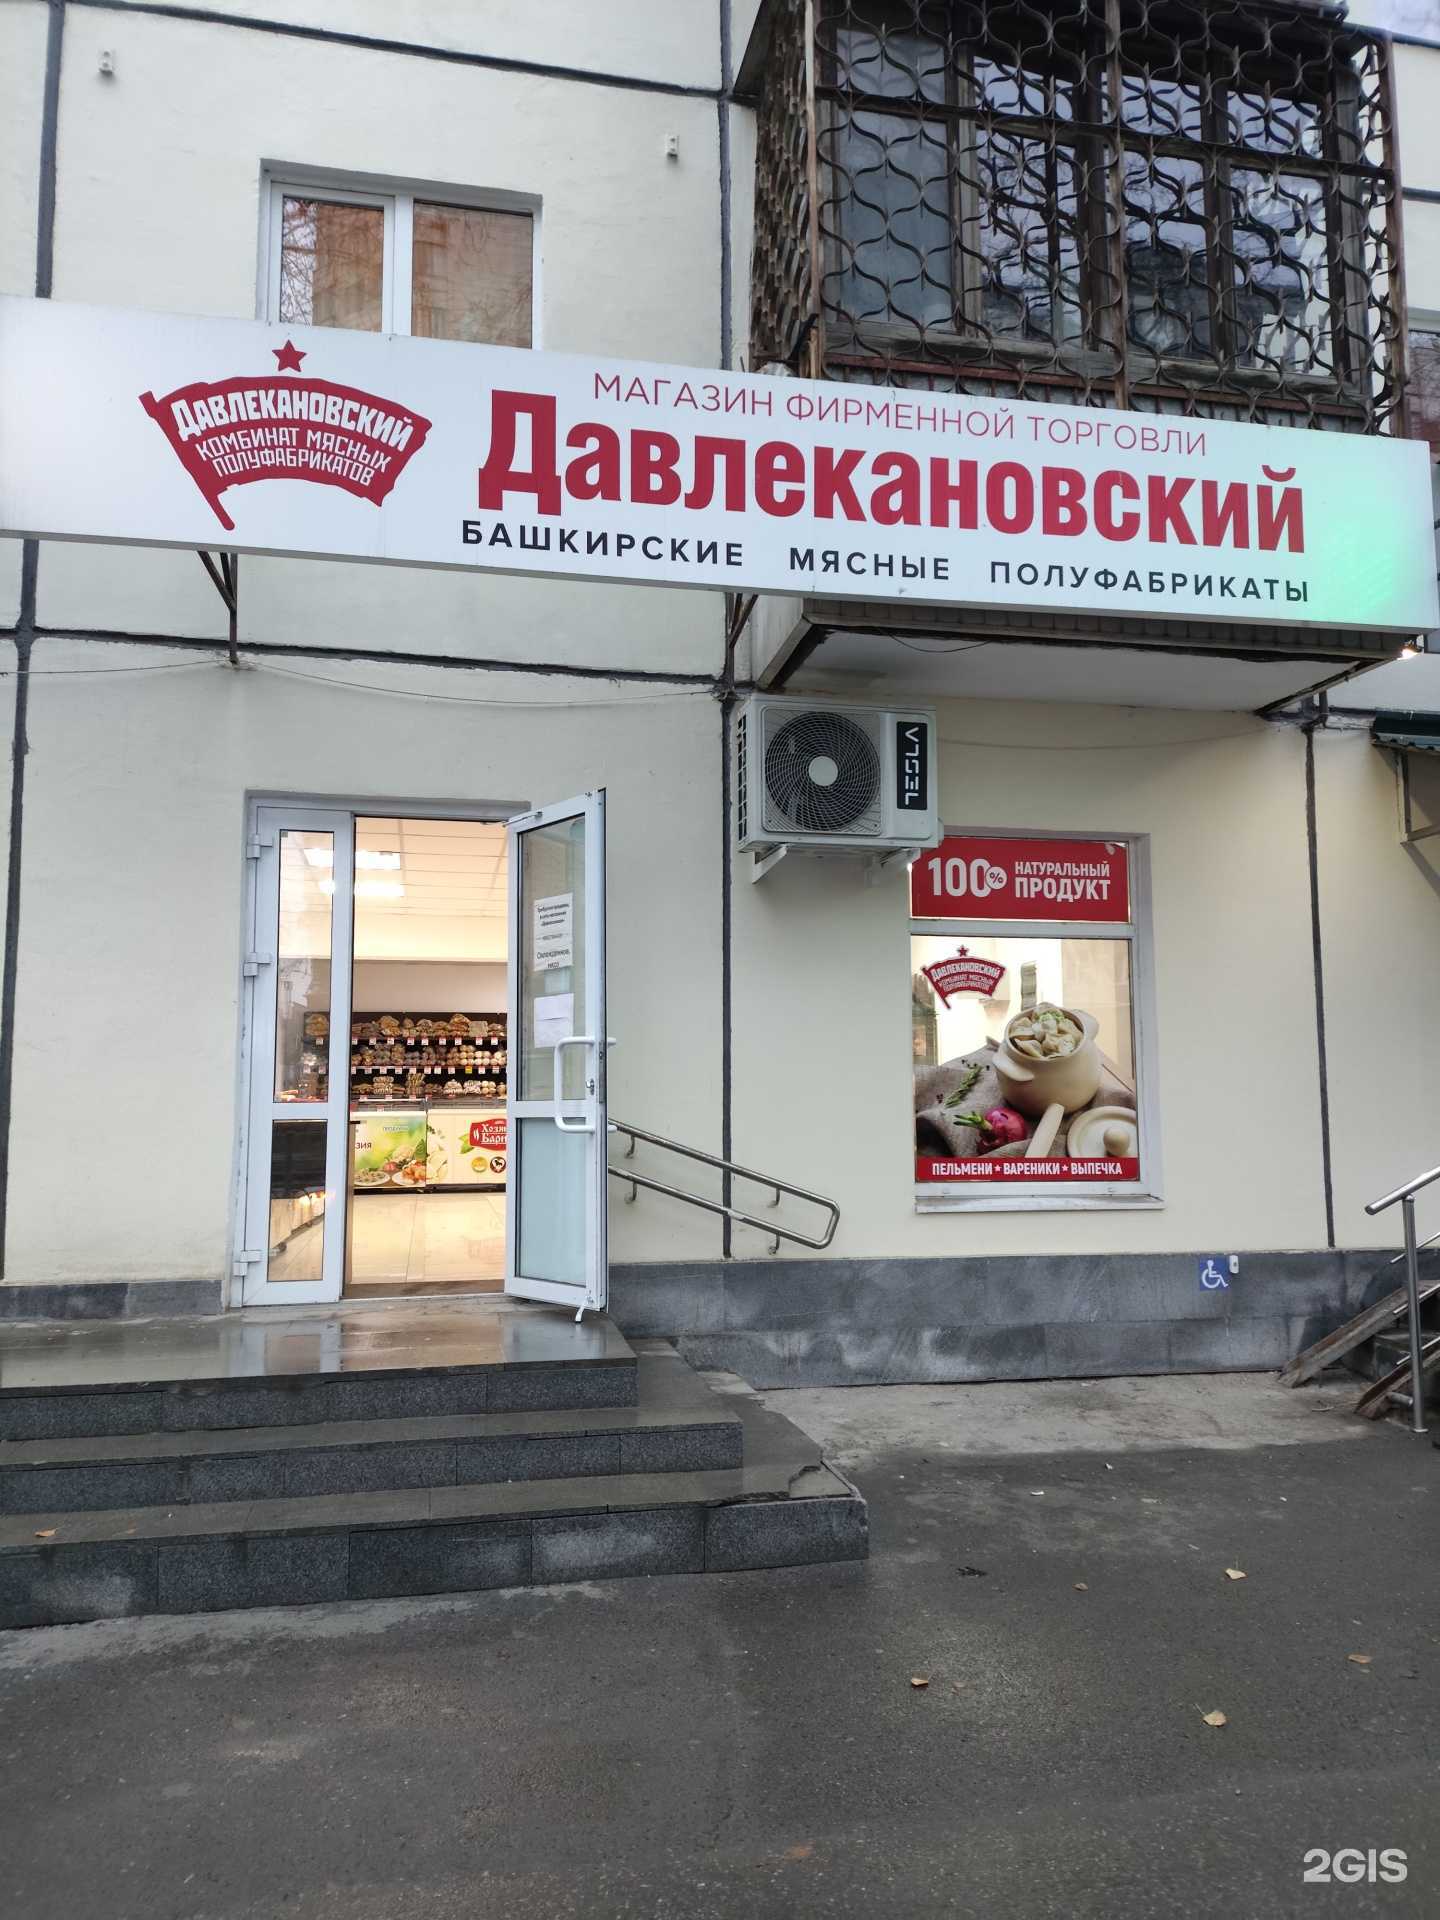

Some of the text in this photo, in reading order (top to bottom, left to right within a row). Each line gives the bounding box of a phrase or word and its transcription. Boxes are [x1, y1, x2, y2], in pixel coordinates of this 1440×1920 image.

[170, 389, 414, 452] ДАВЛЕКАНОВСКИЙ
[594, 373, 1206, 456] МАГАЗИН ФИРМЕННОЙ ТОРГОВЛИ
[195, 427, 391, 472] КОМБИНАТ МЯСНЫХ
[212, 448, 375, 486] ПОЛУФАБРИКАТОВ
[478, 389, 1305, 553] Давлекановский
[462, 519, 1308, 602] БАШКИРСКИЕ МЯСНЫЕ ПОЛУФАБРИКАТЫ
[905, 727, 919, 805] TESLA
[1015, 860, 1110, 876] НАТУРАЛЬНЫЙ
[1015, 877, 1111, 902] ПРОДУКТ
[932, 1162, 1123, 1175] ПЕЛЬМЕНИ ВАРЕНИКИ ВЫПЕЧКА
